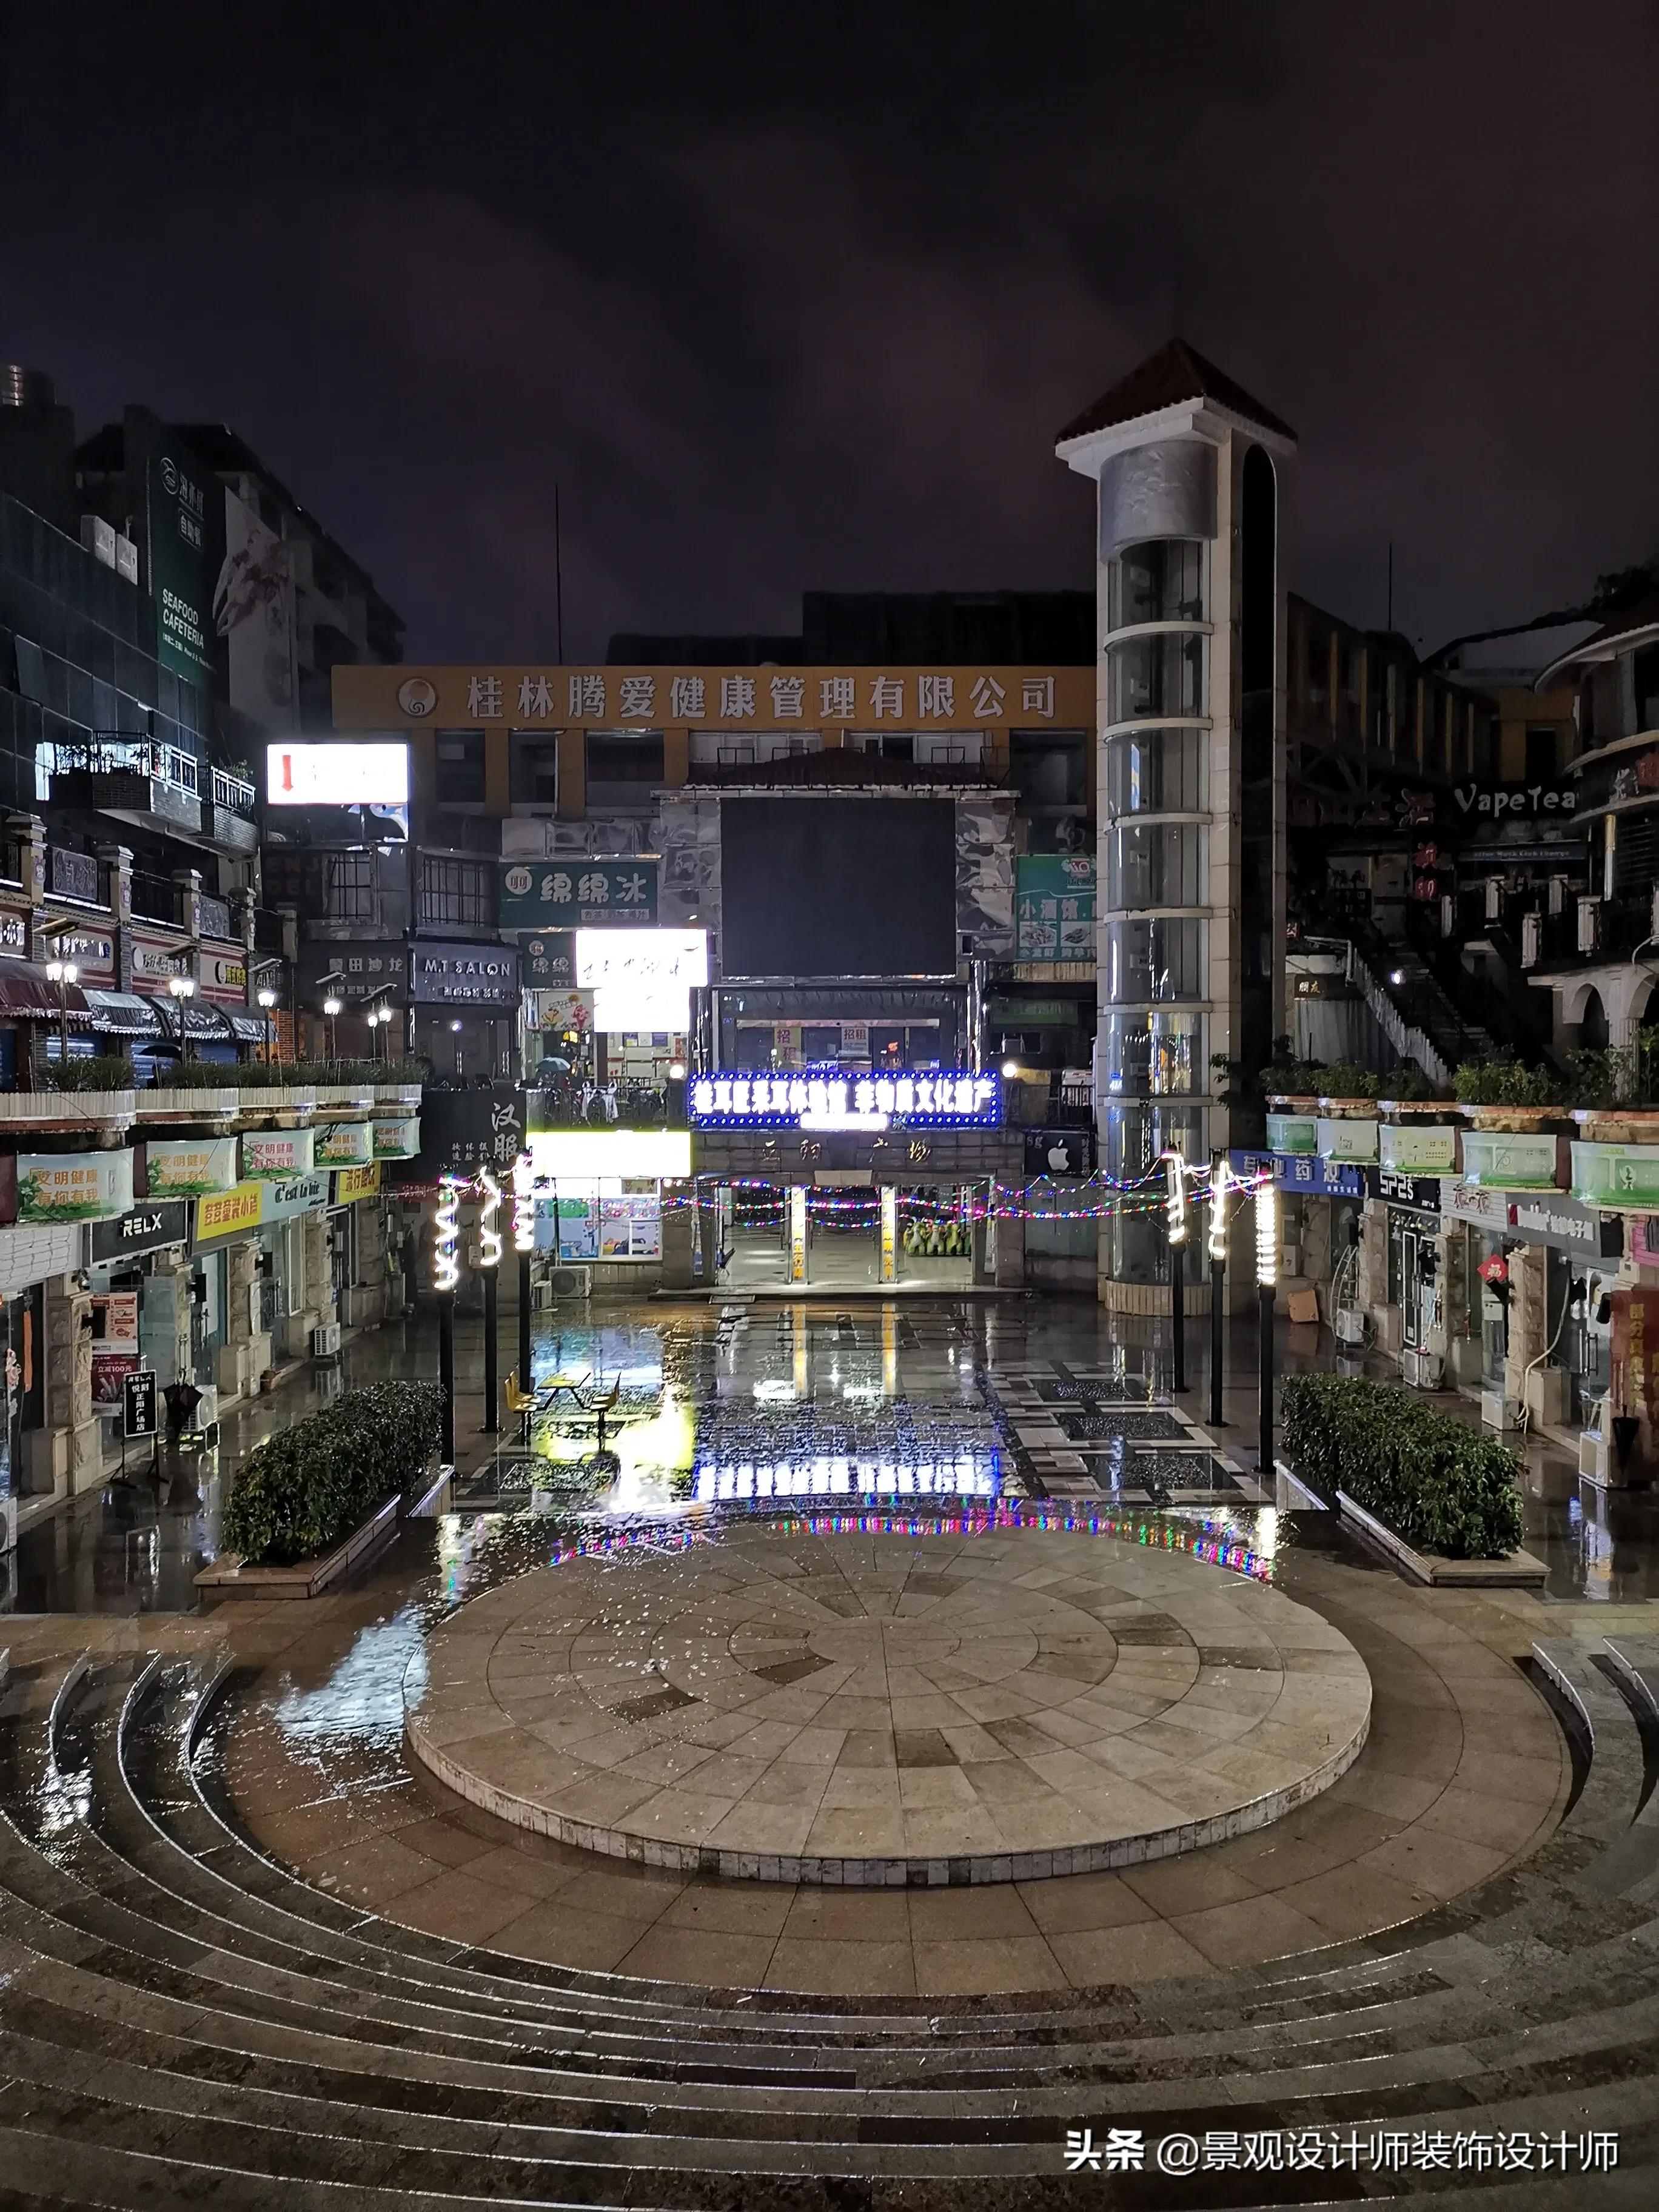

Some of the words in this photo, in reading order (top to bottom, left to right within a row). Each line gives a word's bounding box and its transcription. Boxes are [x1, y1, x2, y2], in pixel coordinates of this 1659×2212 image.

[163, 588, 199, 625] SEAFOOD
[163, 608, 204, 649] CAFETERIA
[467, 674, 1056, 720] 桂林腾爱健康管理有限公司
[1454, 784, 1576, 818] VapeTea
[540, 873, 647, 903] 绵绵冰
[455, 960, 510, 977] SALON
[843, 1030, 866, 1041] 招租
[492, 1102, 521, 1162] 汉服
[123, 1213, 162, 1238] RELX
[128, 1374, 152, 1382] RELX
